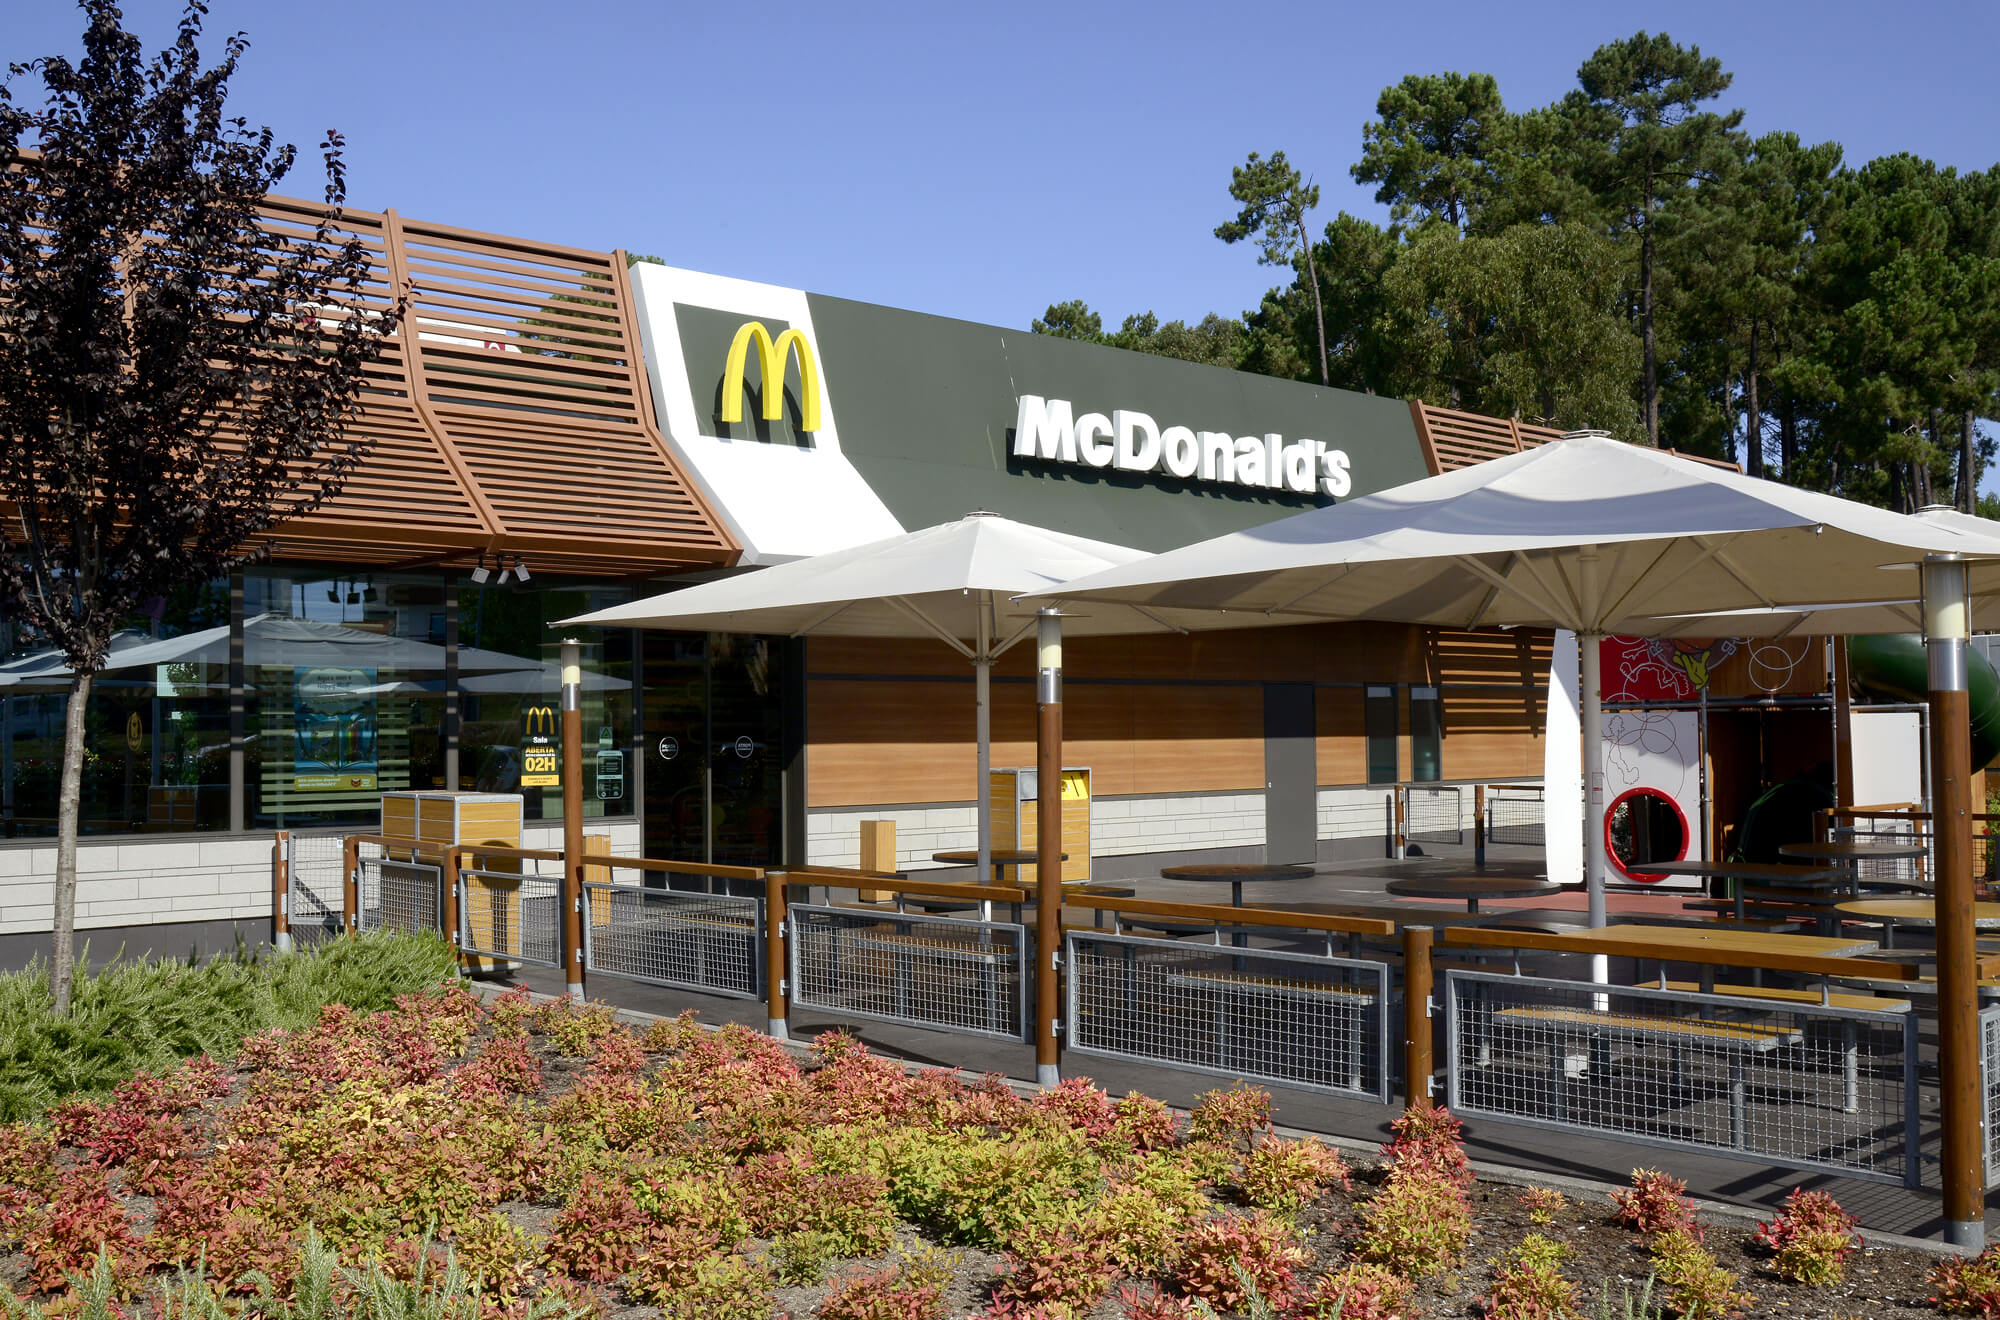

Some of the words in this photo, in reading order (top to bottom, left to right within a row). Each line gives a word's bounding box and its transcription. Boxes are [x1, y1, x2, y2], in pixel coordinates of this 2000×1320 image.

[1014, 394, 1351, 497] McDonald's
[533, 736, 548, 744] Sala
[525, 745, 555, 754] ABERTA
[525, 757, 556, 772] 02H
